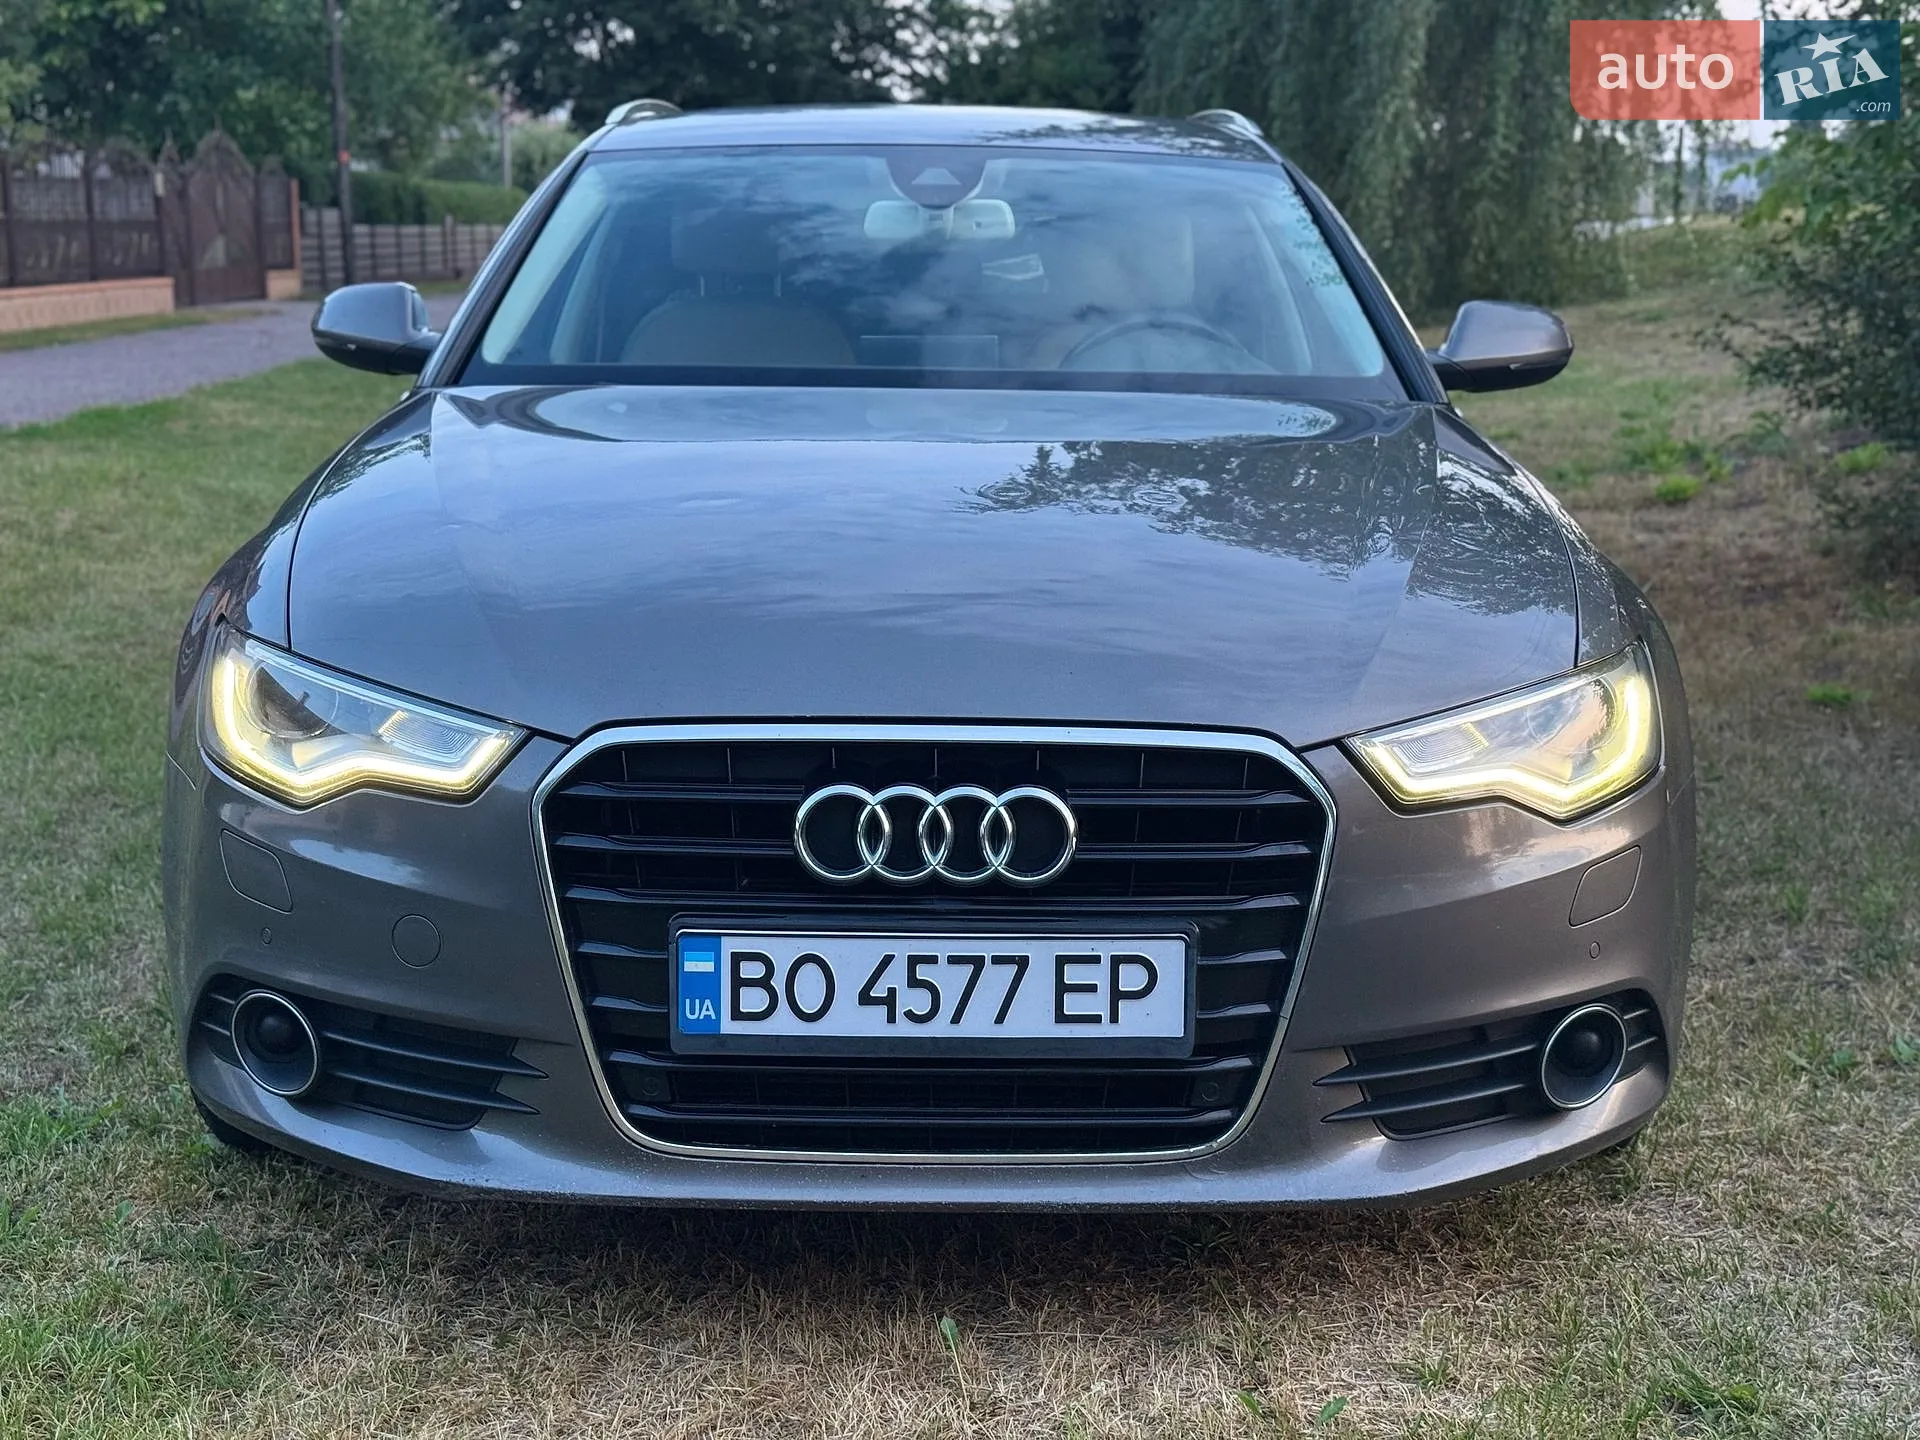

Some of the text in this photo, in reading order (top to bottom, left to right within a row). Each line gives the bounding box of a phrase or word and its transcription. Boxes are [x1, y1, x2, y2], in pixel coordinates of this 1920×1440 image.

[685, 999, 716, 1020] UA
[729, 951, 1159, 1025] BO 4577 EP
